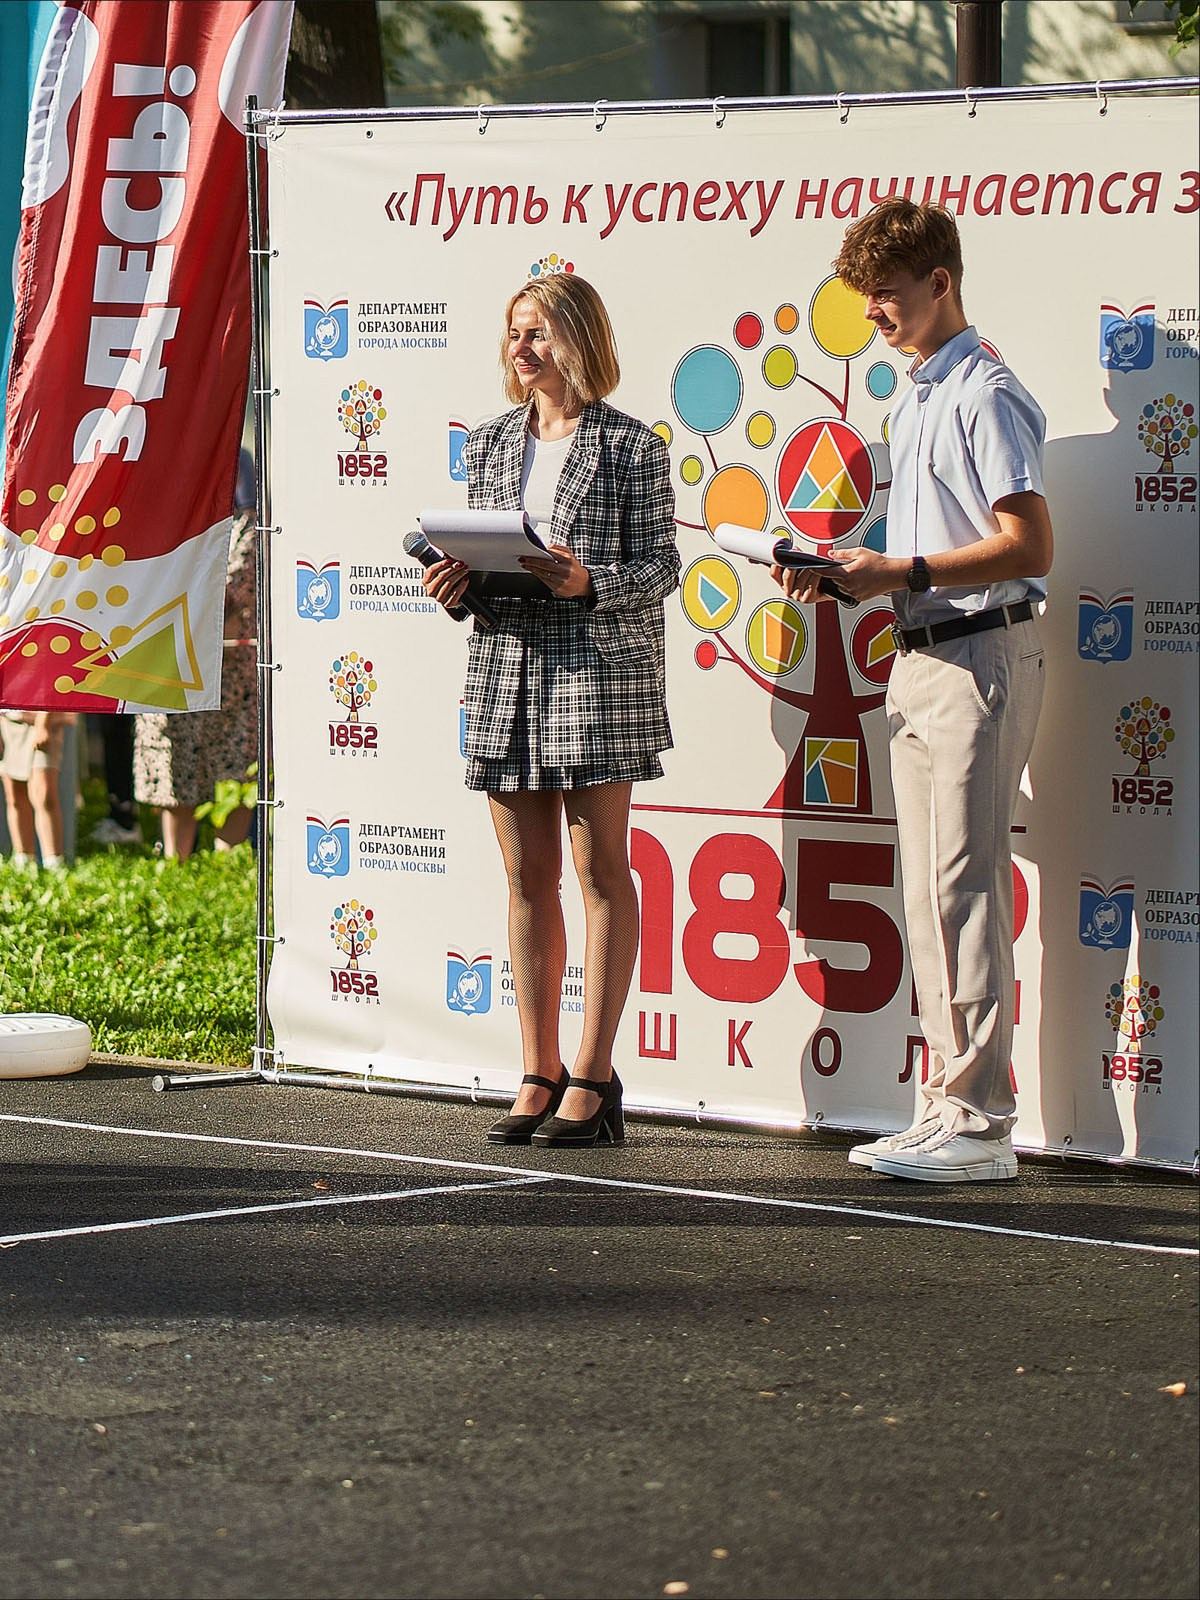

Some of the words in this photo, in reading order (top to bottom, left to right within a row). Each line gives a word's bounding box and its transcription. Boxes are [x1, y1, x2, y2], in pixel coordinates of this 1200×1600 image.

[384, 173, 549, 242] «Путь
[562, 184, 593, 224] к
[600, 179, 786, 240] успеху
[795, 171, 1162, 219] начинается
[73, 63, 196, 464] ЗДЕСЬ!
[358, 303, 447, 317] ДЕПАРТАМЕНТ
[1167, 308, 1199, 324] ДЕП
[358, 321, 447, 333] ОБРАЗОВАНИЯ
[358, 338, 398, 350] ГОРОДА
[400, 337, 447, 348] МОСКВЫ
[1166, 347, 1199, 358] ГОРО
[337, 454, 387, 477] 1852
[1135, 476, 1197, 503] 1852
[1136, 504, 1196, 512] ШКОЛА
[349, 566, 425, 579] ДЕПАРТАМЕ
[350, 583, 428, 597] ОБРАЗОВАНИ
[350, 600, 389, 612] ГОРОДА
[392, 602, 437, 613] МОСКВЫ
[1145, 621, 1199, 635] ОБРАЗО
[1144, 640, 1192, 653] ГОРОДА
[329, 724, 378, 748] 1852
[330, 749, 377, 758] ШКОЛА
[1112, 777, 1174, 805] 1852
[1112, 806, 1172, 816] ШКОЛА
[358, 824, 445, 841] ДЕПАРТАМЕНТ
[359, 841, 445, 858] ОБРАЗОВАНИЯ
[359, 858, 398, 871] ГОРОДА
[400, 861, 446, 874] МОСКВЫ
[1145, 909, 1199, 925] ОБРАЗО
[630, 827, 1028, 1024] 185
[1144, 928, 1192, 943] ГОРОДА
[330, 970, 379, 996] 1852
[331, 994, 380, 1005] ШКОЛА
[638, 1011, 1018, 1094] ШКОЛ
[1102, 1053, 1163, 1084] 1852
[1103, 1081, 1161, 1094] ШКОЛА
